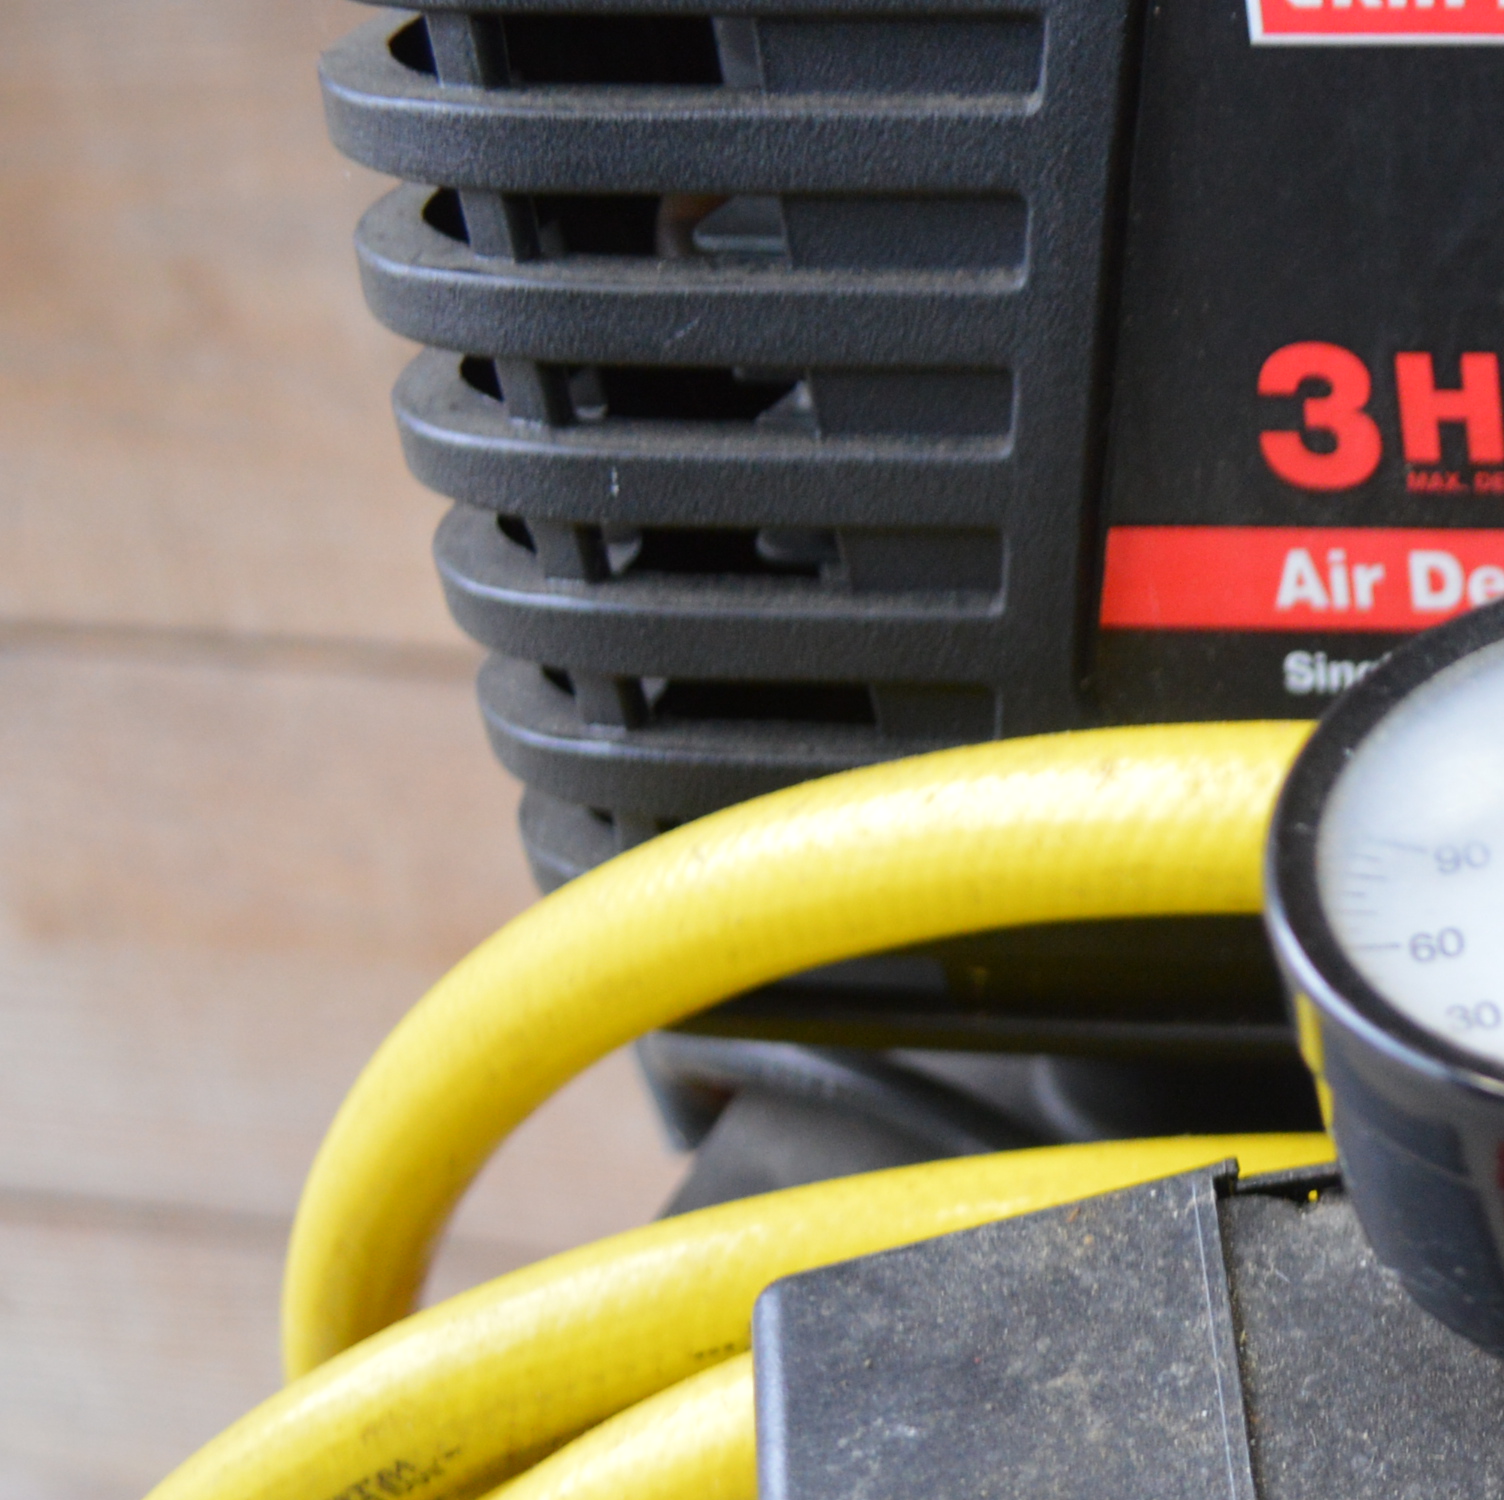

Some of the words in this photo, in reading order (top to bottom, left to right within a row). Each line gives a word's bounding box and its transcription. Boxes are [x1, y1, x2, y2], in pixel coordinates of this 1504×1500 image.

[1257, 340, 1383, 491] 3
[1275, 548, 1385, 612] Air
[1284, 650, 1392, 693] Sin
[1434, 839, 1492, 874] 90
[1409, 926, 1465, 964] 60
[1446, 998, 1503, 1032] 30
